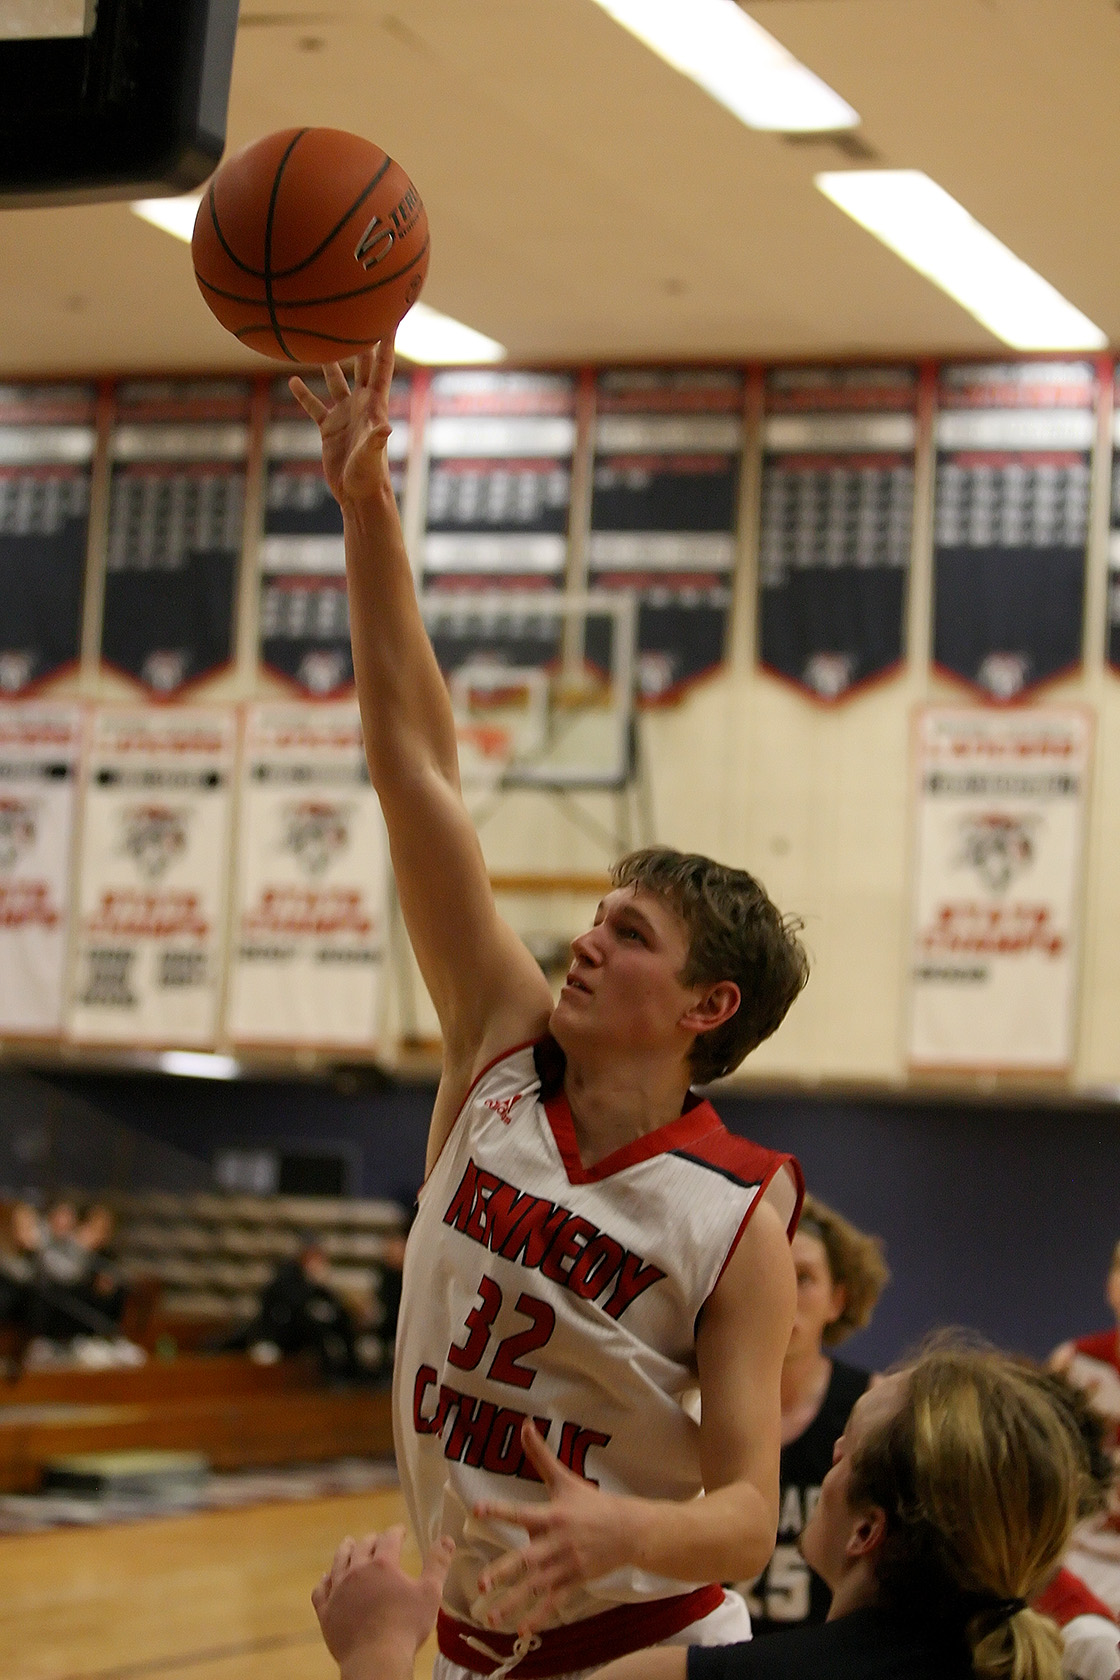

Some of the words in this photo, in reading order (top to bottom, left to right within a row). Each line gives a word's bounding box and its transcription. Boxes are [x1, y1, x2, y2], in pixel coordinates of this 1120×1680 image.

[442, 1157, 667, 1320] KENNEDY
[447, 1274, 556, 1390] 32
[413, 1363, 612, 1487] CTHOLIC
